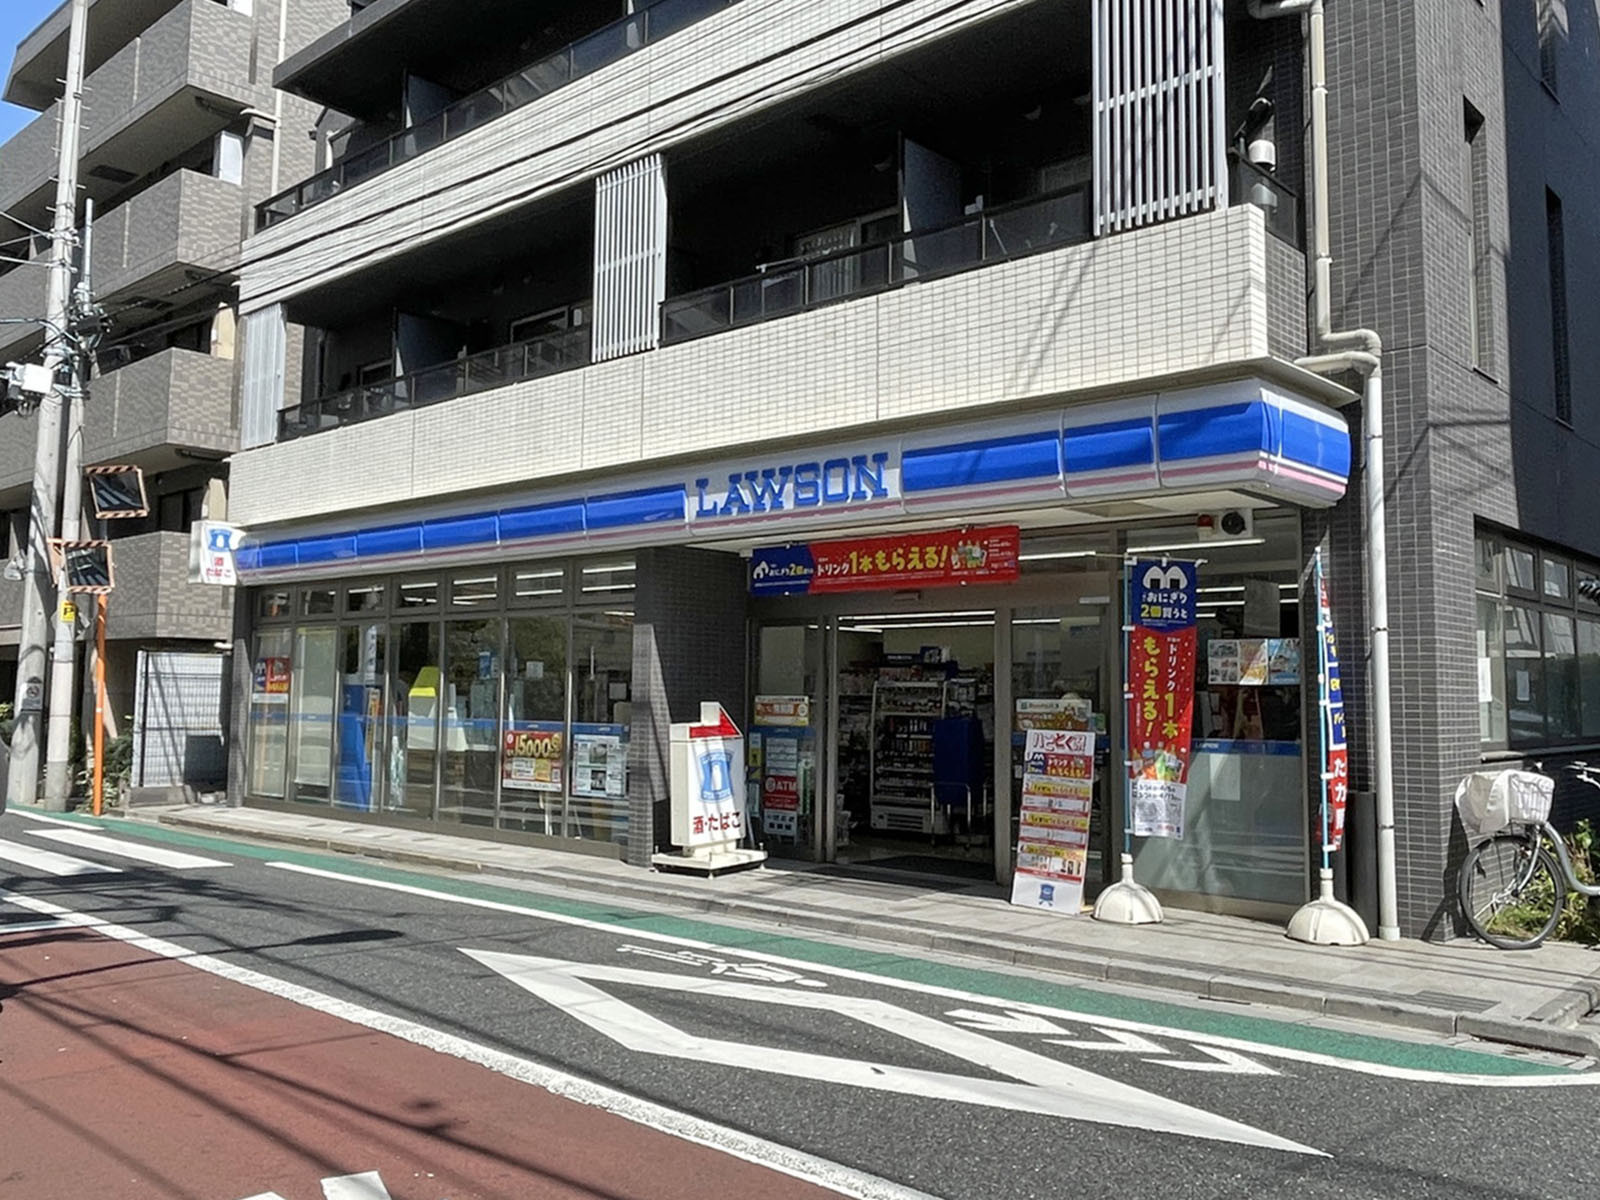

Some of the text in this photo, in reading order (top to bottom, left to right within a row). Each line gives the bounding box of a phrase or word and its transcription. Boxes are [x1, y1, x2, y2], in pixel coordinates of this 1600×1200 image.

[695, 452, 888, 517] LAWSON
[1147, 591, 1188, 604] おにぎり
[775, 780, 797, 792] ATM
